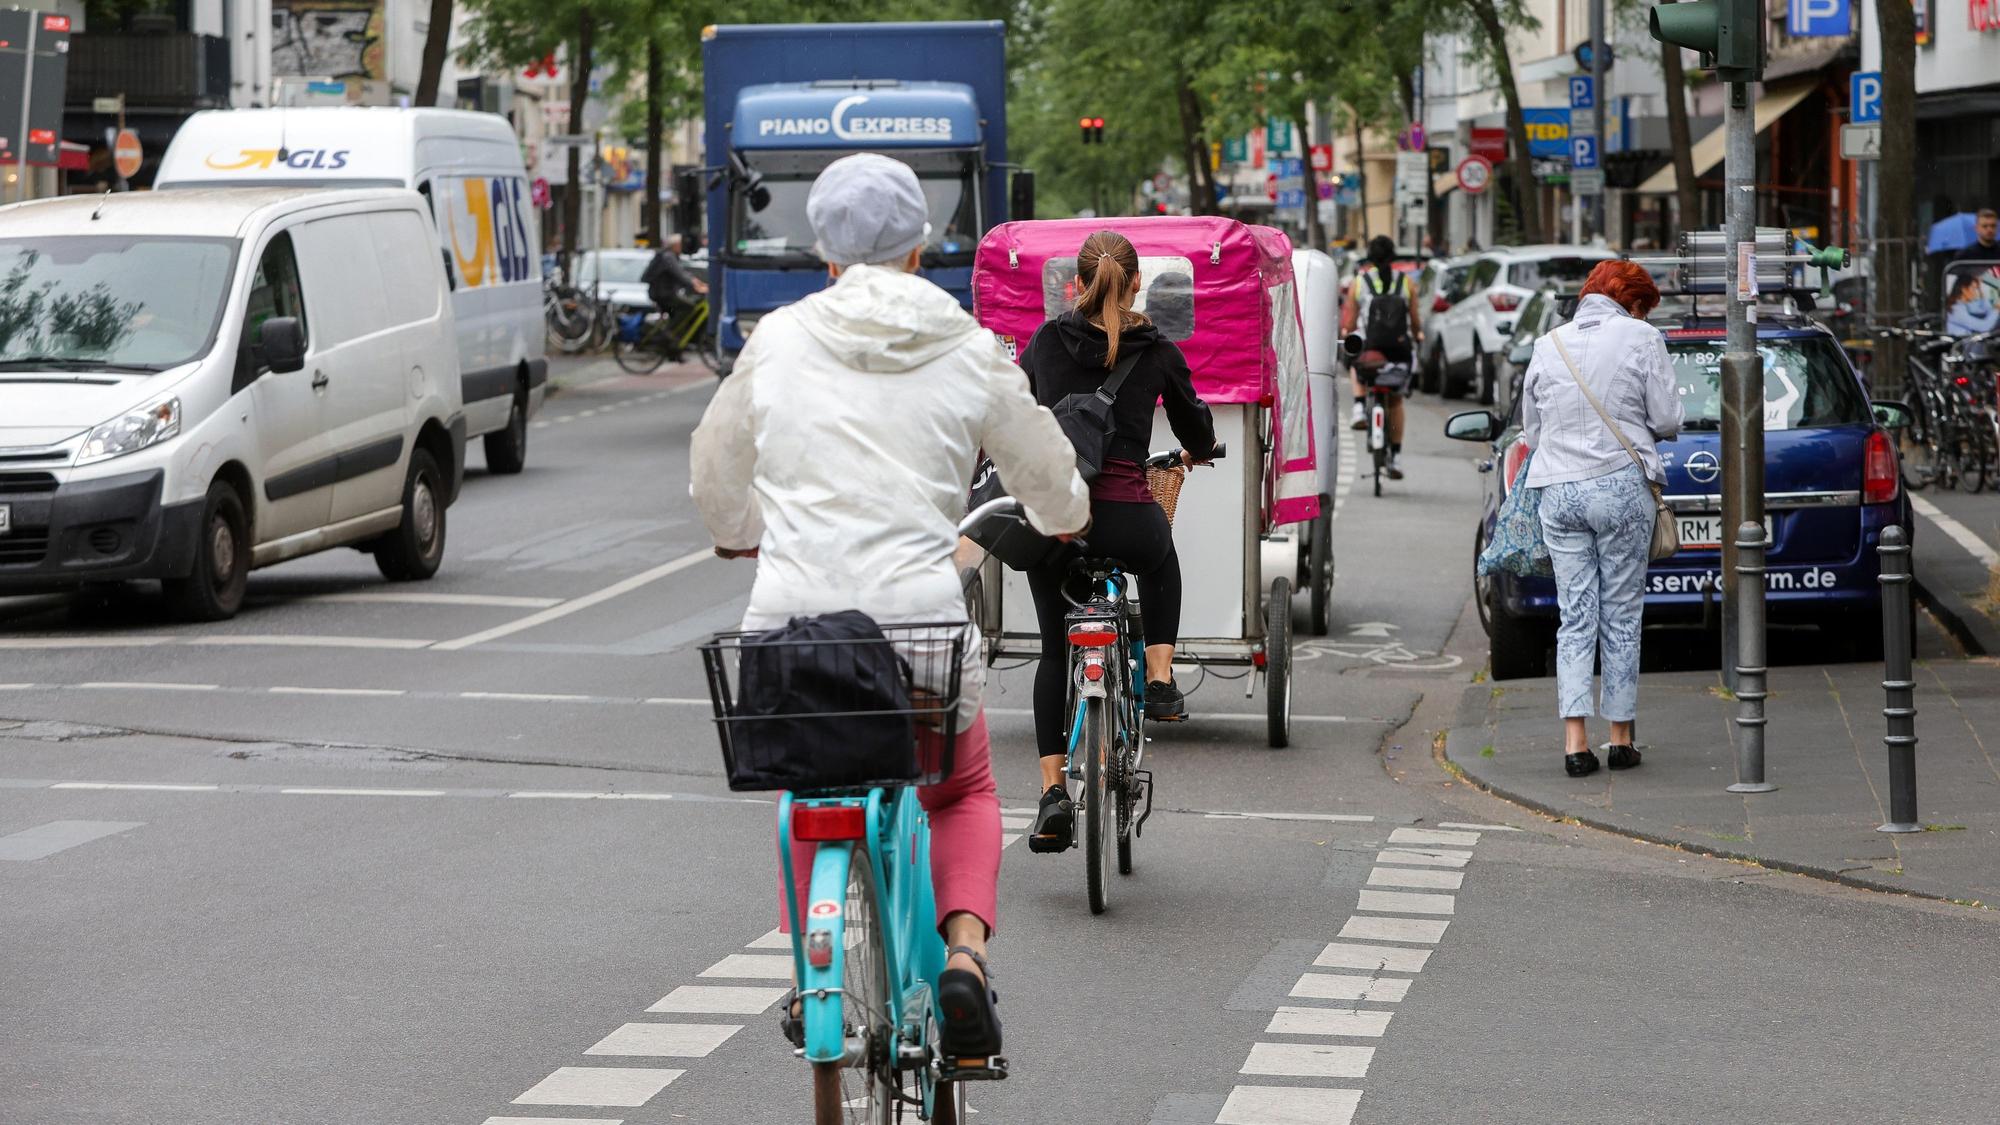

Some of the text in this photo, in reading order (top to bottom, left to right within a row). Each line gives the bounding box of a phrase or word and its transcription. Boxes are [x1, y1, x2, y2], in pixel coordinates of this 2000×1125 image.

[1859, 77, 1881, 117] P
[850, 117, 951, 133] EXPRESS
[287, 150, 350, 169] GLS
[492, 177, 529, 282] GLS
[1682, 520, 1710, 541] RM
